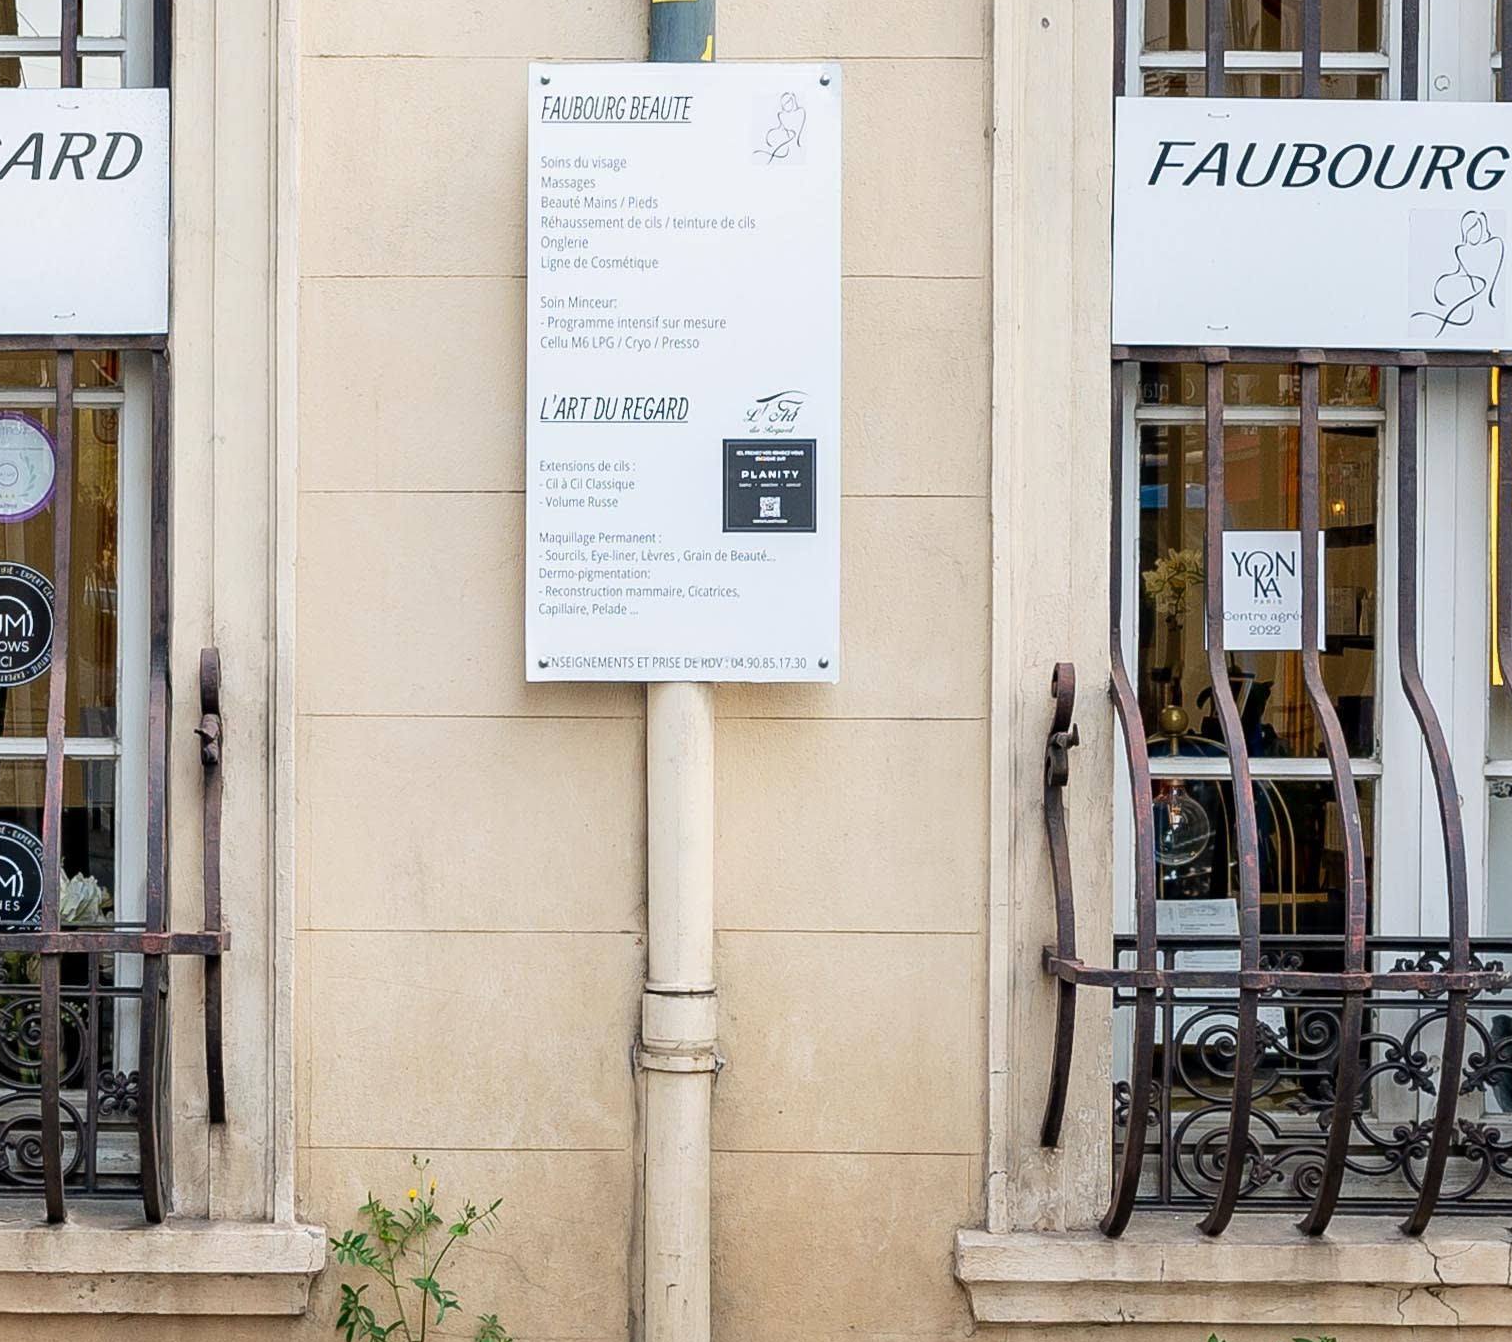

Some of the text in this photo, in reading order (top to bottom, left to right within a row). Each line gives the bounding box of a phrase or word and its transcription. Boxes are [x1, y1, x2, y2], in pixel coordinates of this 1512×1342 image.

[541, 95, 693, 121] FAUBOURG BEAUTE
[540, 155, 627, 173] Soins du visage
[1147, 141, 1510, 192] FAUBOURG
[540, 175, 596, 193] Massages
[540, 195, 581, 209] Beauté
[583, 195, 618, 210] Mains
[628, 195, 659, 210] Pieds
[540, 214, 625, 229] Réhaussement
[627, 215, 643, 229] de
[644, 215, 663, 230] cils
[672, 216, 718, 230] teinture
[720, 215, 735, 230] de
[737, 215, 756, 230] cils
[540, 235, 589, 253] Onglerie
[540, 255, 659, 273] Ligne de Cosmétique
[540, 295, 618, 310] Soin Minceur:
[547, 315, 615, 333] Programme
[617, 314, 660, 330] intensif
[661, 318, 681, 330] sur
[683, 318, 727, 330] mesure
[540, 335, 569, 349] Cellu
[571, 335, 590, 350] M6
[591, 335, 615, 350] LPG
[624, 335, 652, 353] Cryo
[661, 335, 700, 350] Presso
[540, 395, 689, 421] L'ART DU REGARD
[539, 459, 596, 473] Extensions
[597, 459, 612, 473] de
[613, 459, 631, 473] cils
[741, 470, 799, 479] PLANITY
[545, 477, 559, 490] Cil
[560, 477, 568, 490] à
[569, 477, 583, 491] Cil
[585, 477, 636, 493] Classique
[544, 495, 586, 508] Volume
[587, 495, 619, 508] Russe
[539, 530, 596, 548] Maquillage
[598, 531, 656, 544] Permanent
[1231, 550, 1295, 577] YON
[1254, 564, 1282, 598] KA
[1223, 610, 1302, 624] Centre agré
[1248, 625, 1281, 636] 2022
[547, 656, 635, 669] ENSEIGNEMENTS
[636, 656, 650, 669] ET
[652, 656, 681, 669] PRISE
[683, 656, 698, 669] DE
[701, 656, 723, 669] RDV
